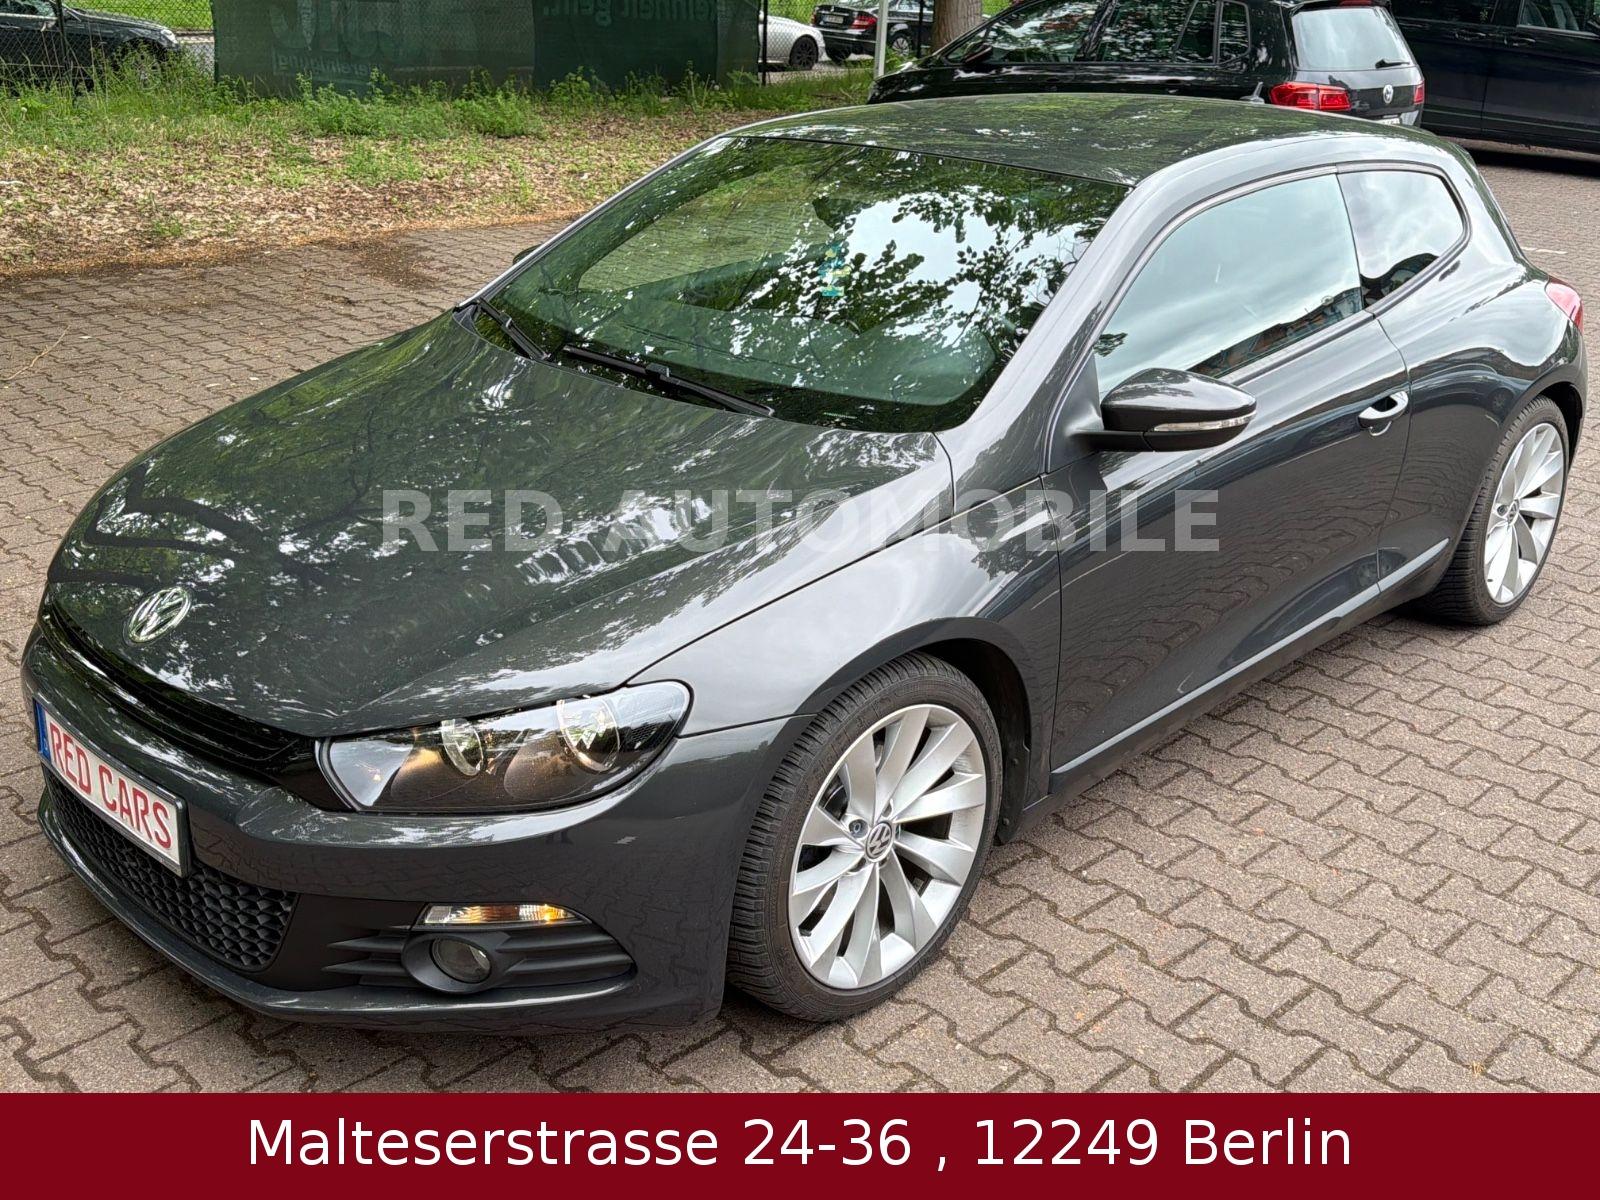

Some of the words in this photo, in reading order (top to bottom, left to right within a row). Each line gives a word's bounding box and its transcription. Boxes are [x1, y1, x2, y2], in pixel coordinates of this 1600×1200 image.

[128, 586, 191, 642] VW
[49, 721, 92, 796] RED
[98, 763, 173, 850] CARS
